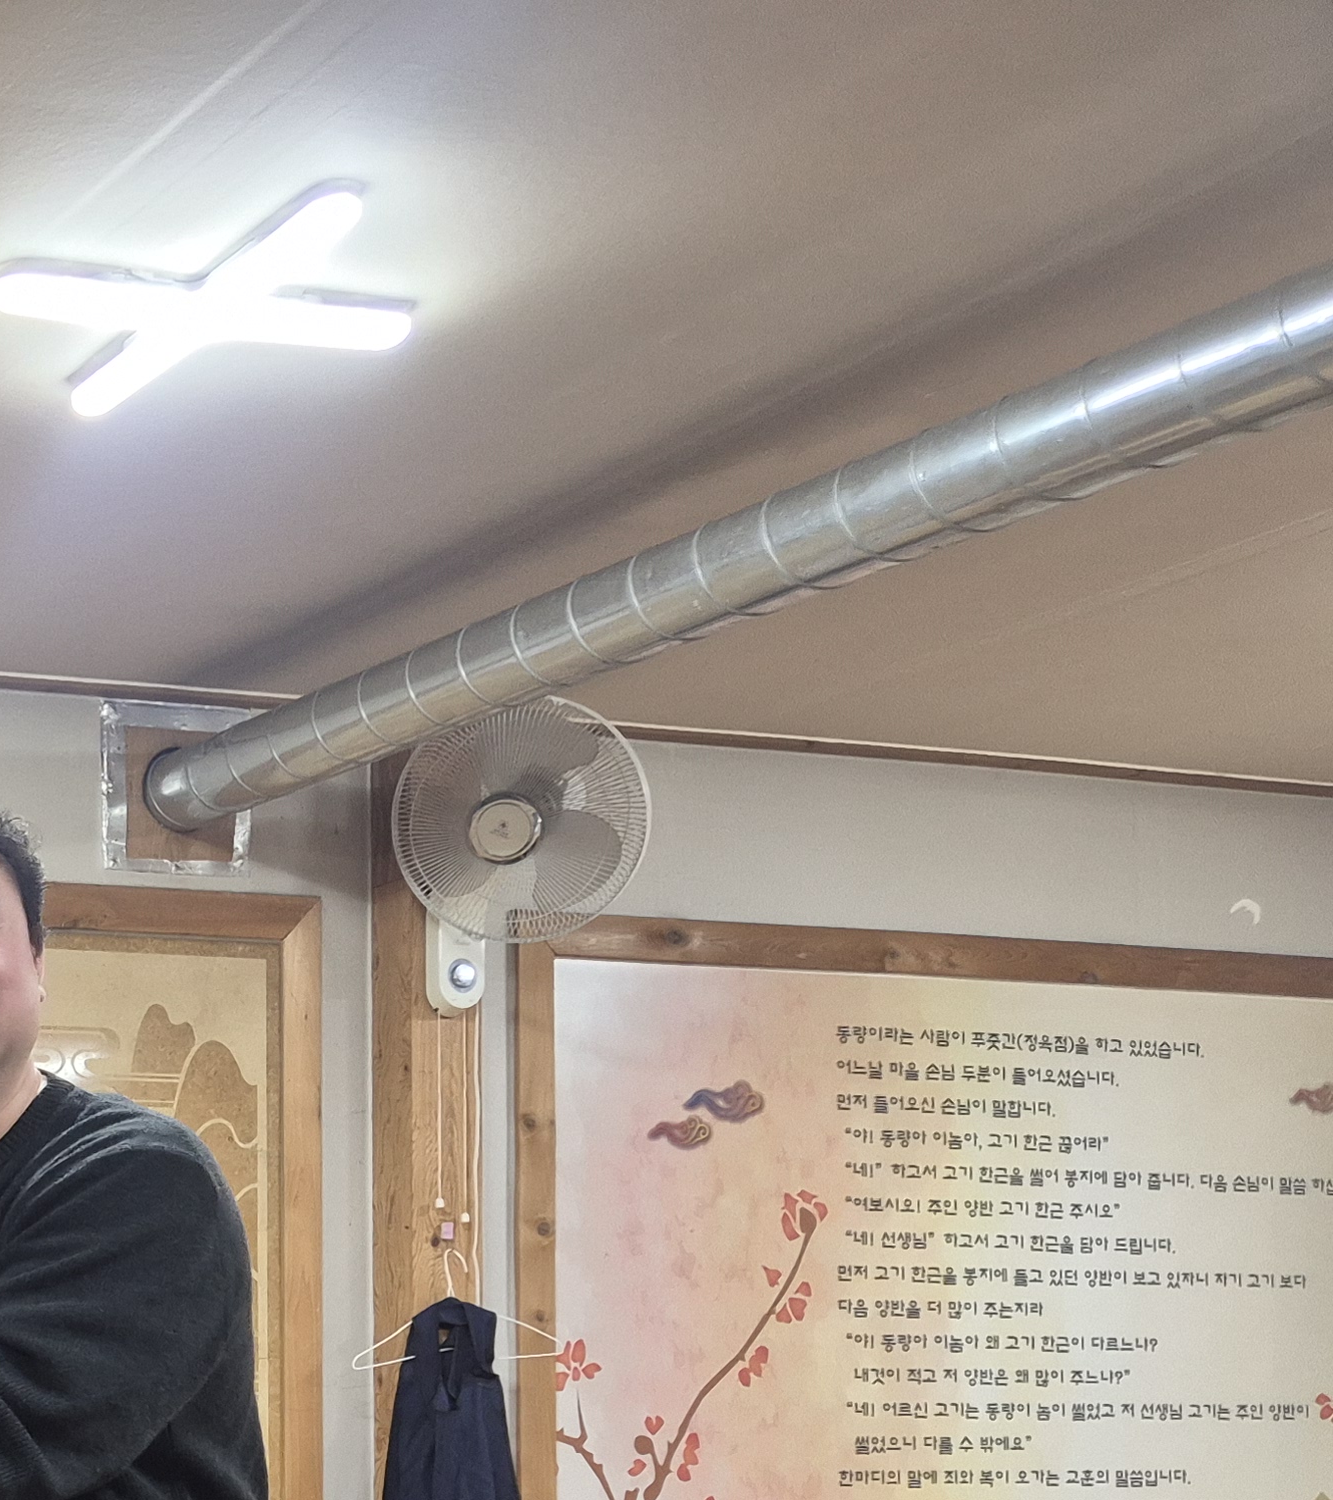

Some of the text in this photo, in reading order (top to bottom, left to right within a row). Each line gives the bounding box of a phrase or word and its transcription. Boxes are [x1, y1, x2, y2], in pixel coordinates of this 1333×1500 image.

[919, 1028, 966, 1048] 사람이
[1094, 1037, 1124, 1054] 하고
[835, 1059, 883, 1081] 어느날
[888, 1061, 920, 1082] 마을
[925, 1063, 956, 1082] 손님
[960, 1065, 1007, 1084] 두분이
[836, 1093, 868, 1111] 먼저
[873, 1095, 936, 1115] 들어오신
[940, 1097, 987, 1116] 손님이
[986, 1133, 1018, 1149] 고기
[1022, 1133, 1053, 1153] 한근
[890, 1163, 937, 1180] 하고서
[941, 1165, 974, 1181] 고기
[978, 1165, 1025, 1187] 한근을
[1029, 1168, 1059, 1188] 썰어
[1064, 1169, 1108, 1189] 봉지에
[1113, 1170, 1142, 1189] 담아
[1199, 1173, 1228, 1194] 다음
[1232, 1174, 1274, 1193] 손님이
[1279, 1176, 1307, 1196] 말씀
[926, 1198, 958, 1217] 주인
[963, 1199, 994, 1218] 양반
[998, 1200, 1030, 1216] 고기
[1034, 1201, 1065, 1220] 한근
[943, 1232, 989, 1249] 하고서
[993, 1234, 1025, 1250] 고기
[1029, 1234, 1075, 1255] 한근을
[1079, 1236, 1109, 1255] 담아
[836, 1264, 1307, 1290] 먼저 고기 한근을 봉지에 들고 있던 양반이 보고 있자니 자기 고기 보다
[836, 1298, 1044, 1320] 다음 양반을 더 많이 주는지라
[933, 1334, 980, 1354] 이놈아
[984, 1334, 1000, 1350] 왜
[1004, 1335, 1036, 1351] 고기
[1040, 1335, 1085, 1354] 한근이
[853, 1367, 901, 1386] 내것이
[906, 1367, 938, 1386] 적고
[942, 1368, 958, 1384] 저
[963, 1368, 1009, 1387] 양반은
[1014, 1368, 1030, 1384] 왜
[1034, 1369, 1065, 1388] 많이
[882, 1401, 928, 1420] 어르신
[933, 1402, 980, 1420] 고기는
[1035, 1402, 1066, 1422] 놈이
[1071, 1402, 1116, 1422] 썰었고
[1120, 1402, 1135, 1418] 저
[1140, 1403, 1183, 1422] 선생님
[1187, 1403, 1231, 1422] 고기는
[1234, 1403, 1264, 1421] 주인
[1268, 1403, 1310, 1422] 양반이
[854, 1435, 917, 1456] 썰었으니
[923, 1435, 954, 1456] 다를
[958, 1435, 974, 1453] 수
[837, 1469, 901, 1488] 한마디의
[907, 1469, 938, 1489] 말에
[943, 1469, 974, 1485] 죄와
[978, 1469, 1010, 1488] 복이
[1014, 1469, 1061, 1488] 오가는
[1065, 1469, 1110, 1488] 교훈의
